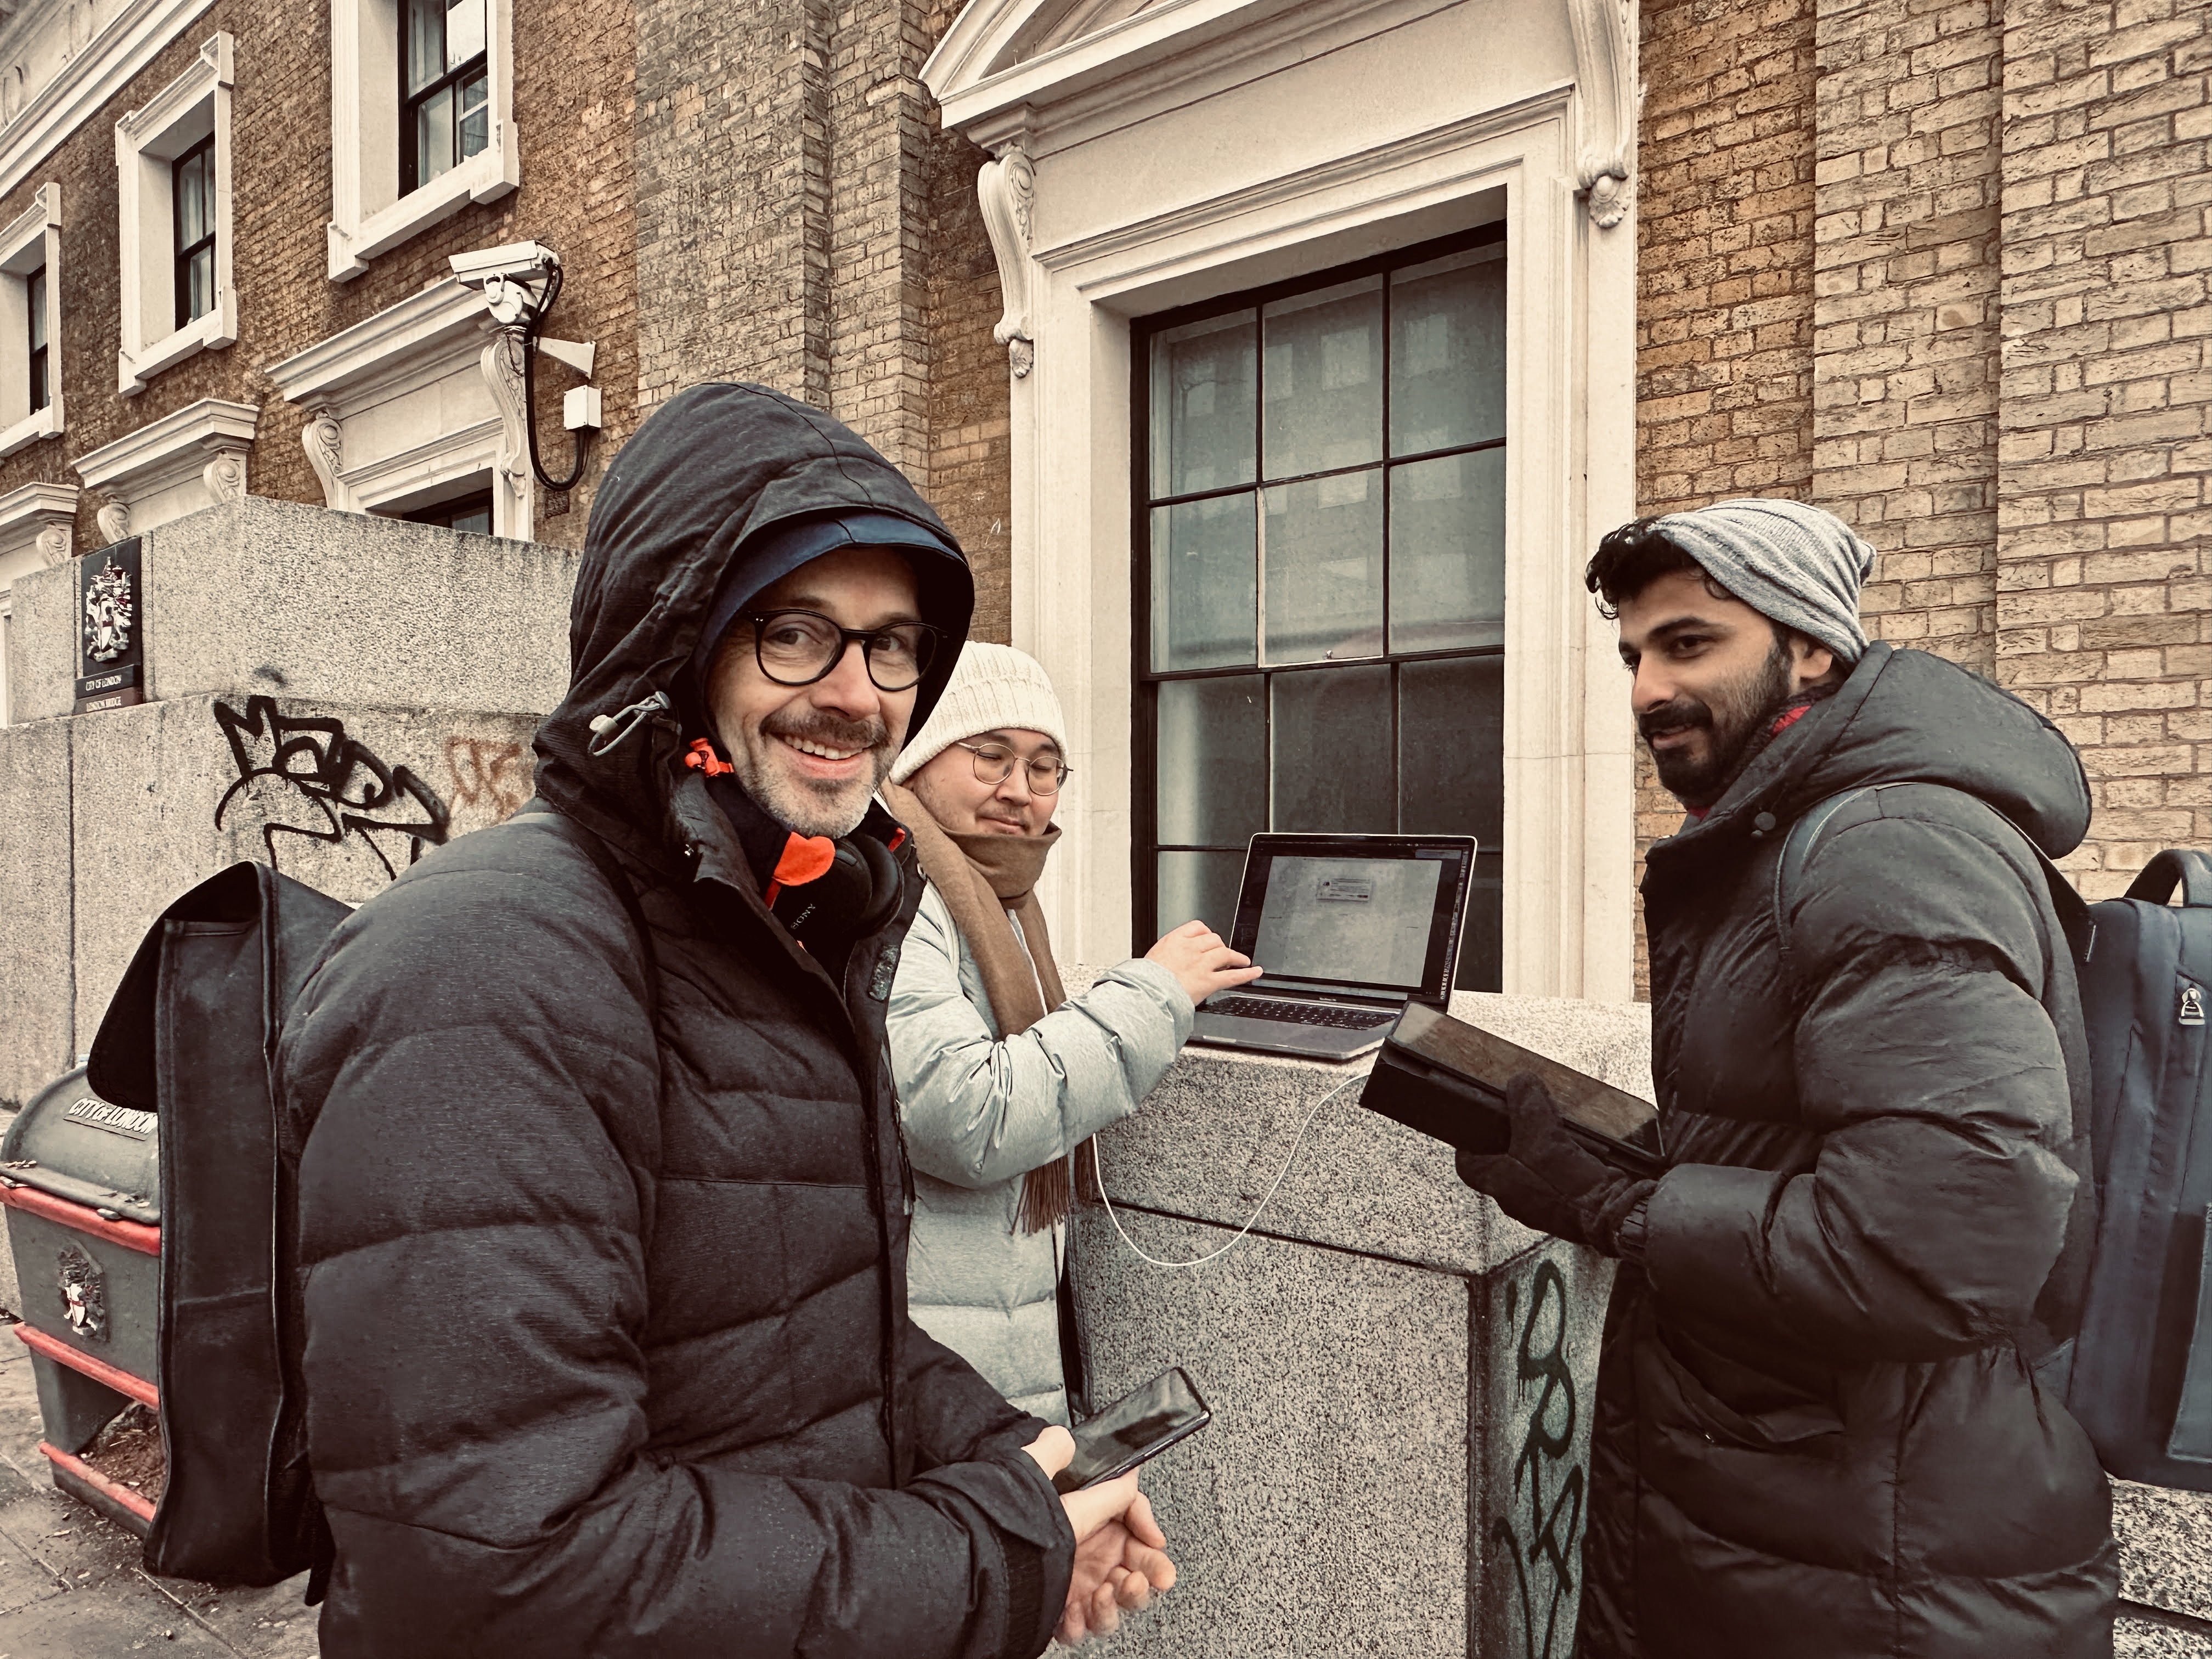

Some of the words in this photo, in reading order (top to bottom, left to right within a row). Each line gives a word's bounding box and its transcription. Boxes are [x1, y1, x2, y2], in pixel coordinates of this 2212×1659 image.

[791, 903, 816, 929] SONY
[69, 1098, 105, 1119] CITY
[104, 1107, 159, 1134] LONDON
